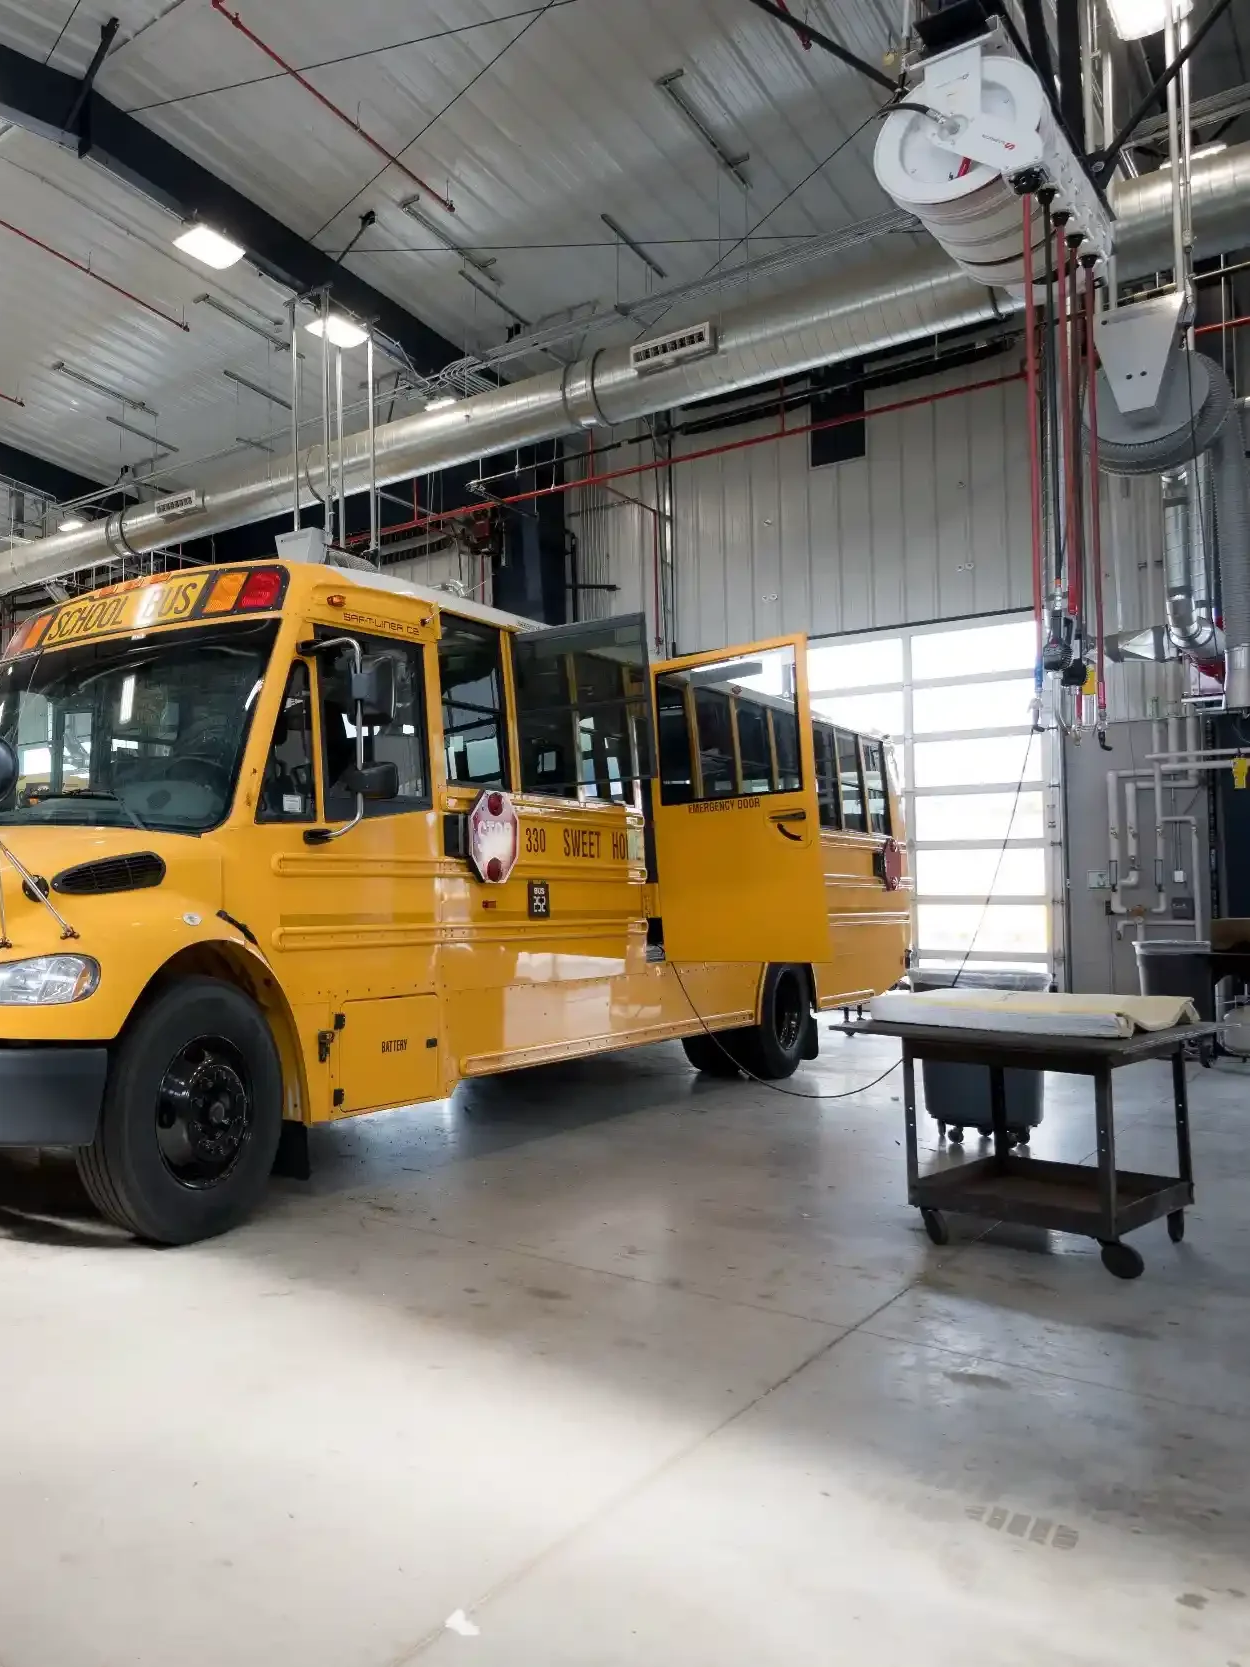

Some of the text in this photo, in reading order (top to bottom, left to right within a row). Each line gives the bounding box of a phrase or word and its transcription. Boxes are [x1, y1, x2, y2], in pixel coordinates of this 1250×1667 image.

[48, 582, 198, 640] SCHOOL BUS
[688, 797, 761, 814] EMERGENCY DOOR
[525, 827, 546, 853] 330
[563, 828, 601, 860] SWEET
[533, 887, 545, 895] BUS
[381, 1039, 408, 1053] BATTERY
